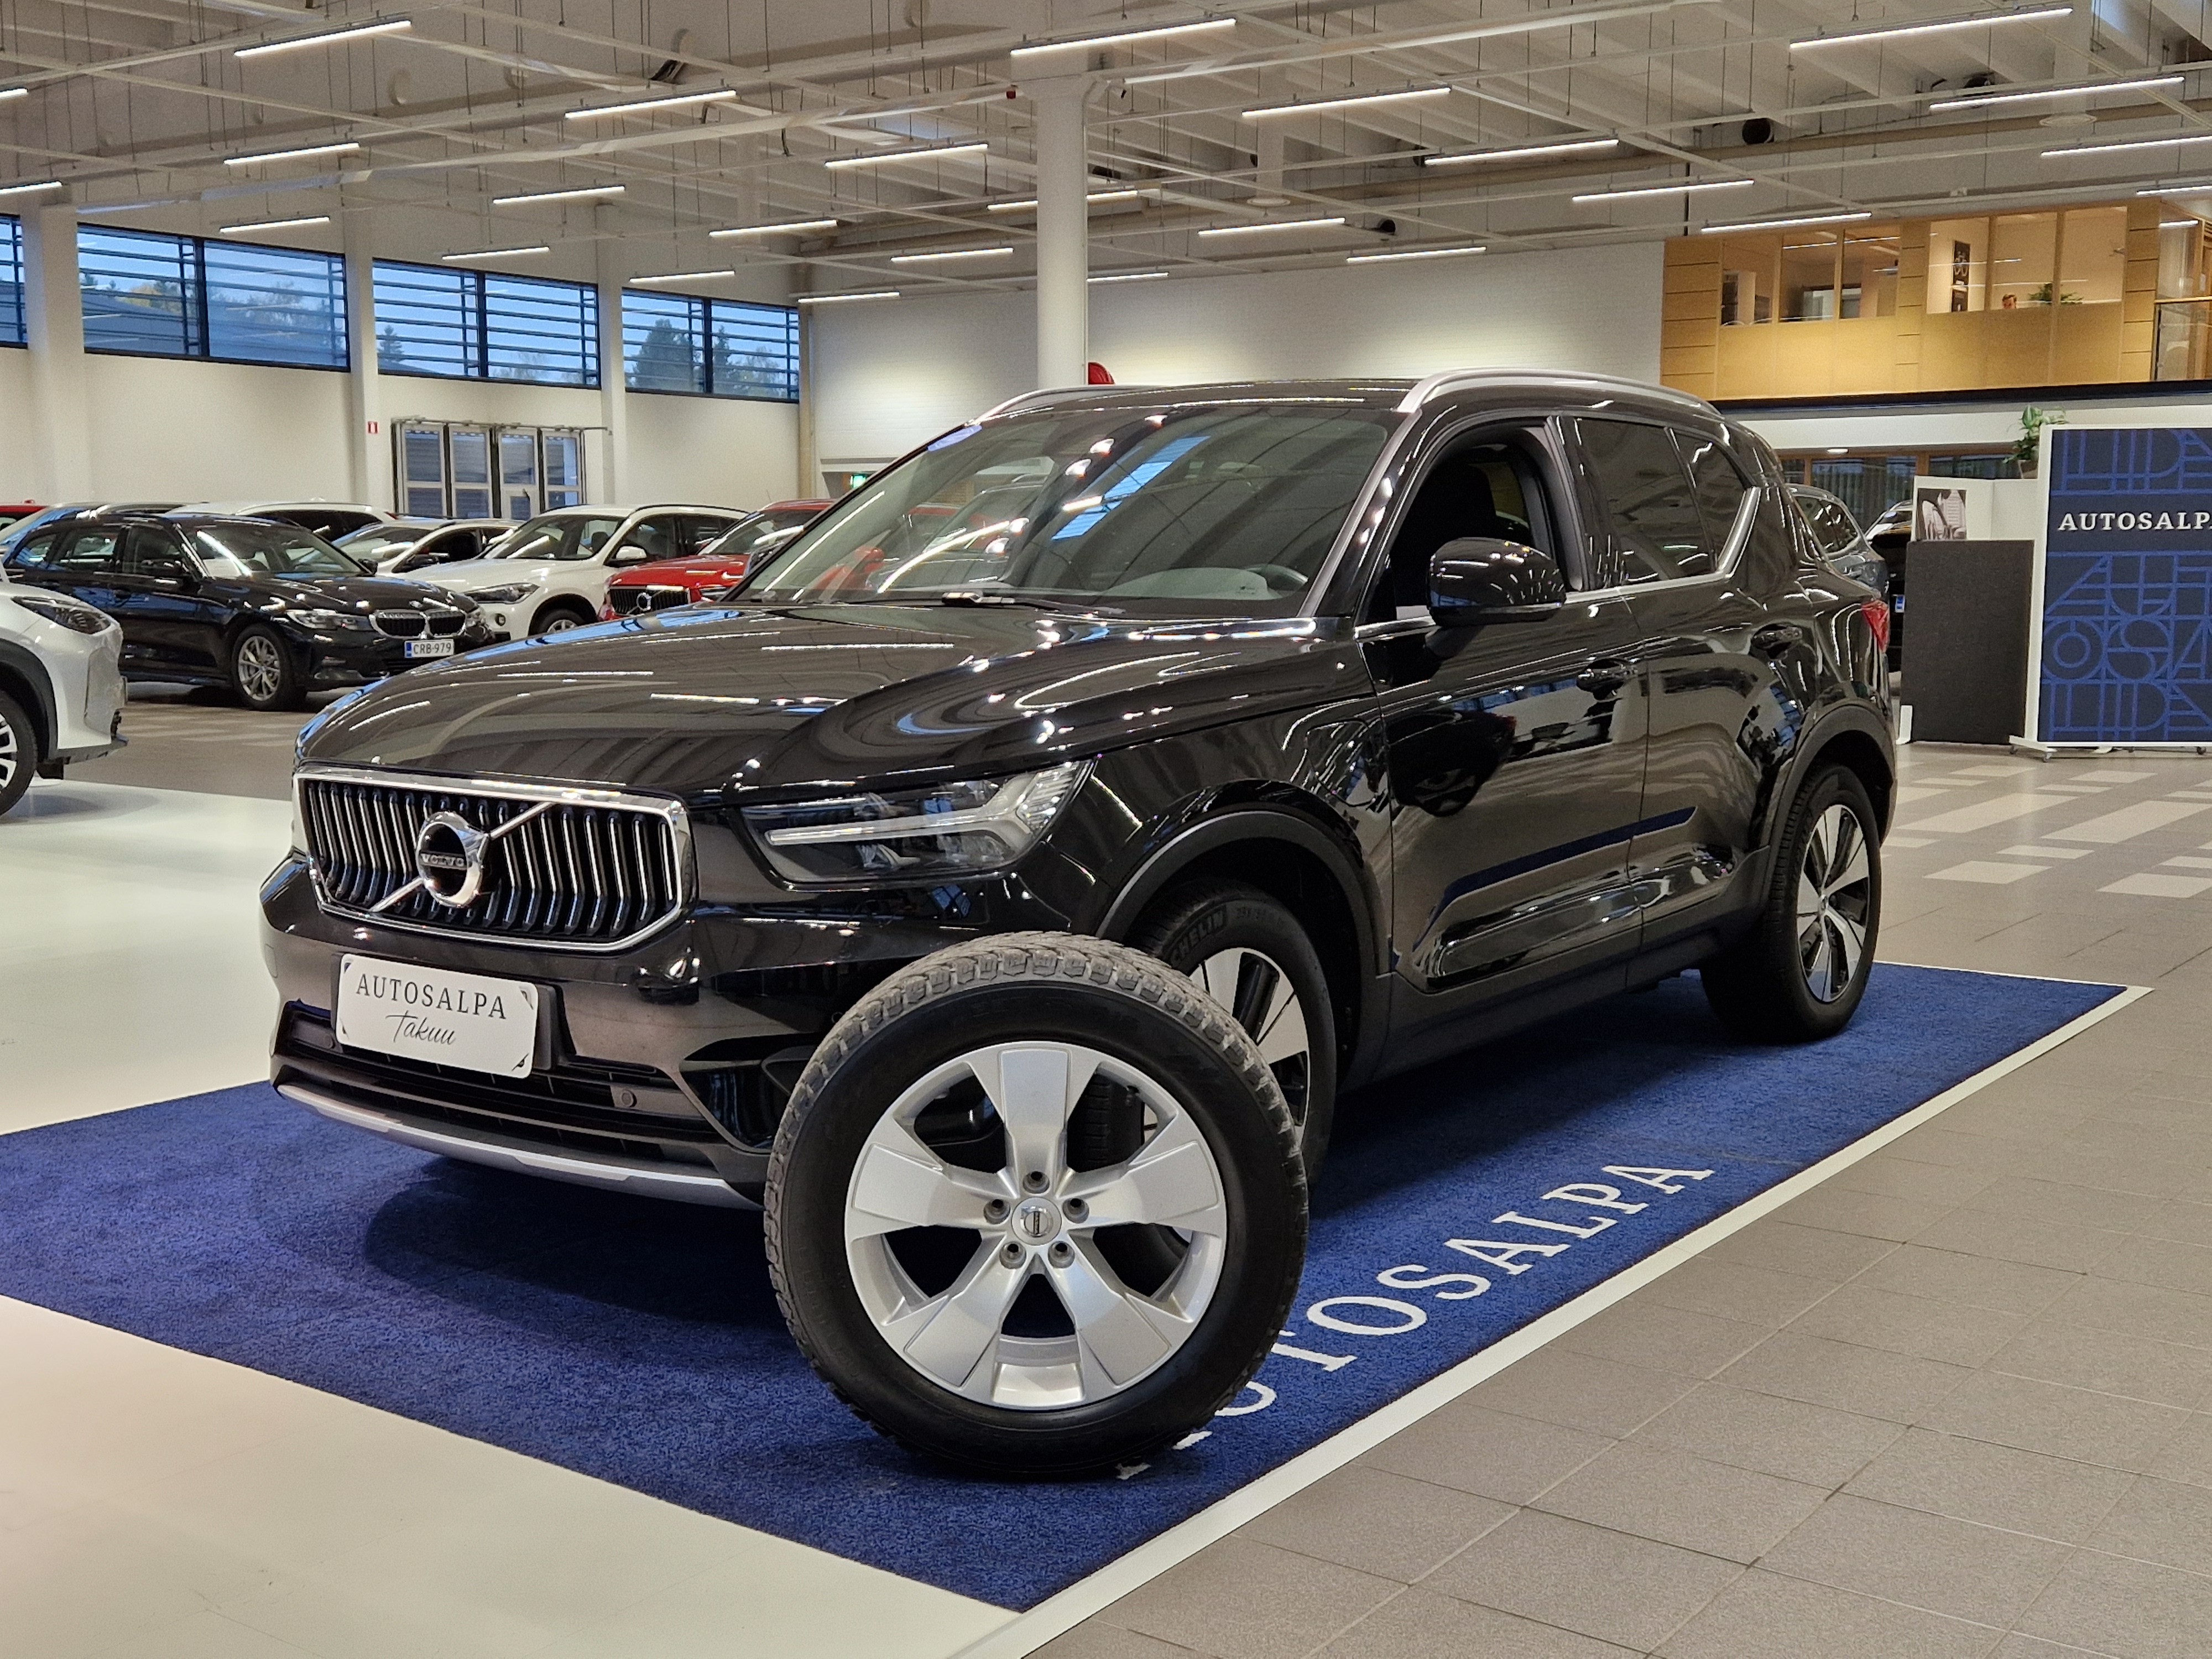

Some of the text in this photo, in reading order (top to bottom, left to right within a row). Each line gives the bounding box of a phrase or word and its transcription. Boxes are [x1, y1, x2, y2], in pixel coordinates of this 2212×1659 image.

[2058, 512, 2212, 531] AUTOSALP
[414, 643, 451, 654] CRB-979
[1170, 910, 1224, 969] CHELIN
[356, 973, 507, 1020] AUTOSALPA
[385, 1010, 456, 1045] Takuu
[1115, 1164, 1715, 1480] TOSALPA
